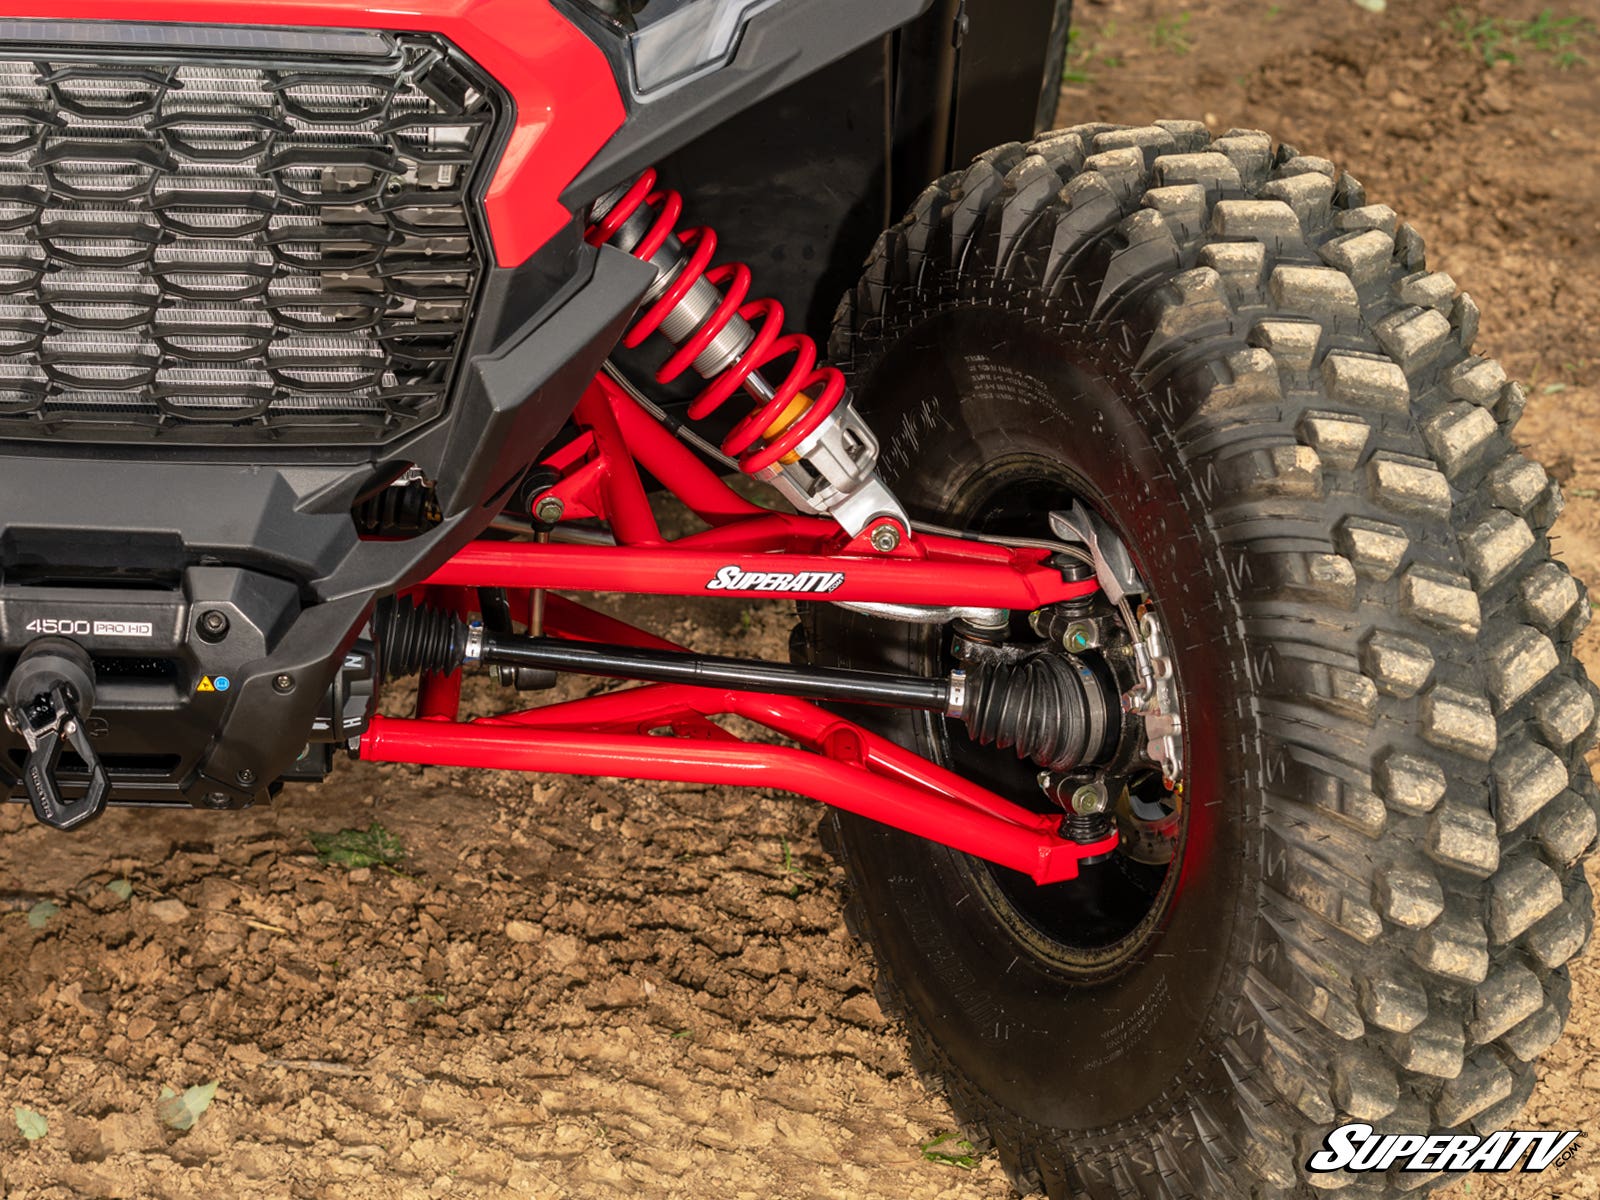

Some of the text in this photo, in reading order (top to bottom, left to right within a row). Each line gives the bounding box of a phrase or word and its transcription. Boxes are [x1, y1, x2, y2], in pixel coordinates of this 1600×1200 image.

[706, 565, 843, 592] SUPERATV
[26, 619, 150, 634] 4500 PRO HD
